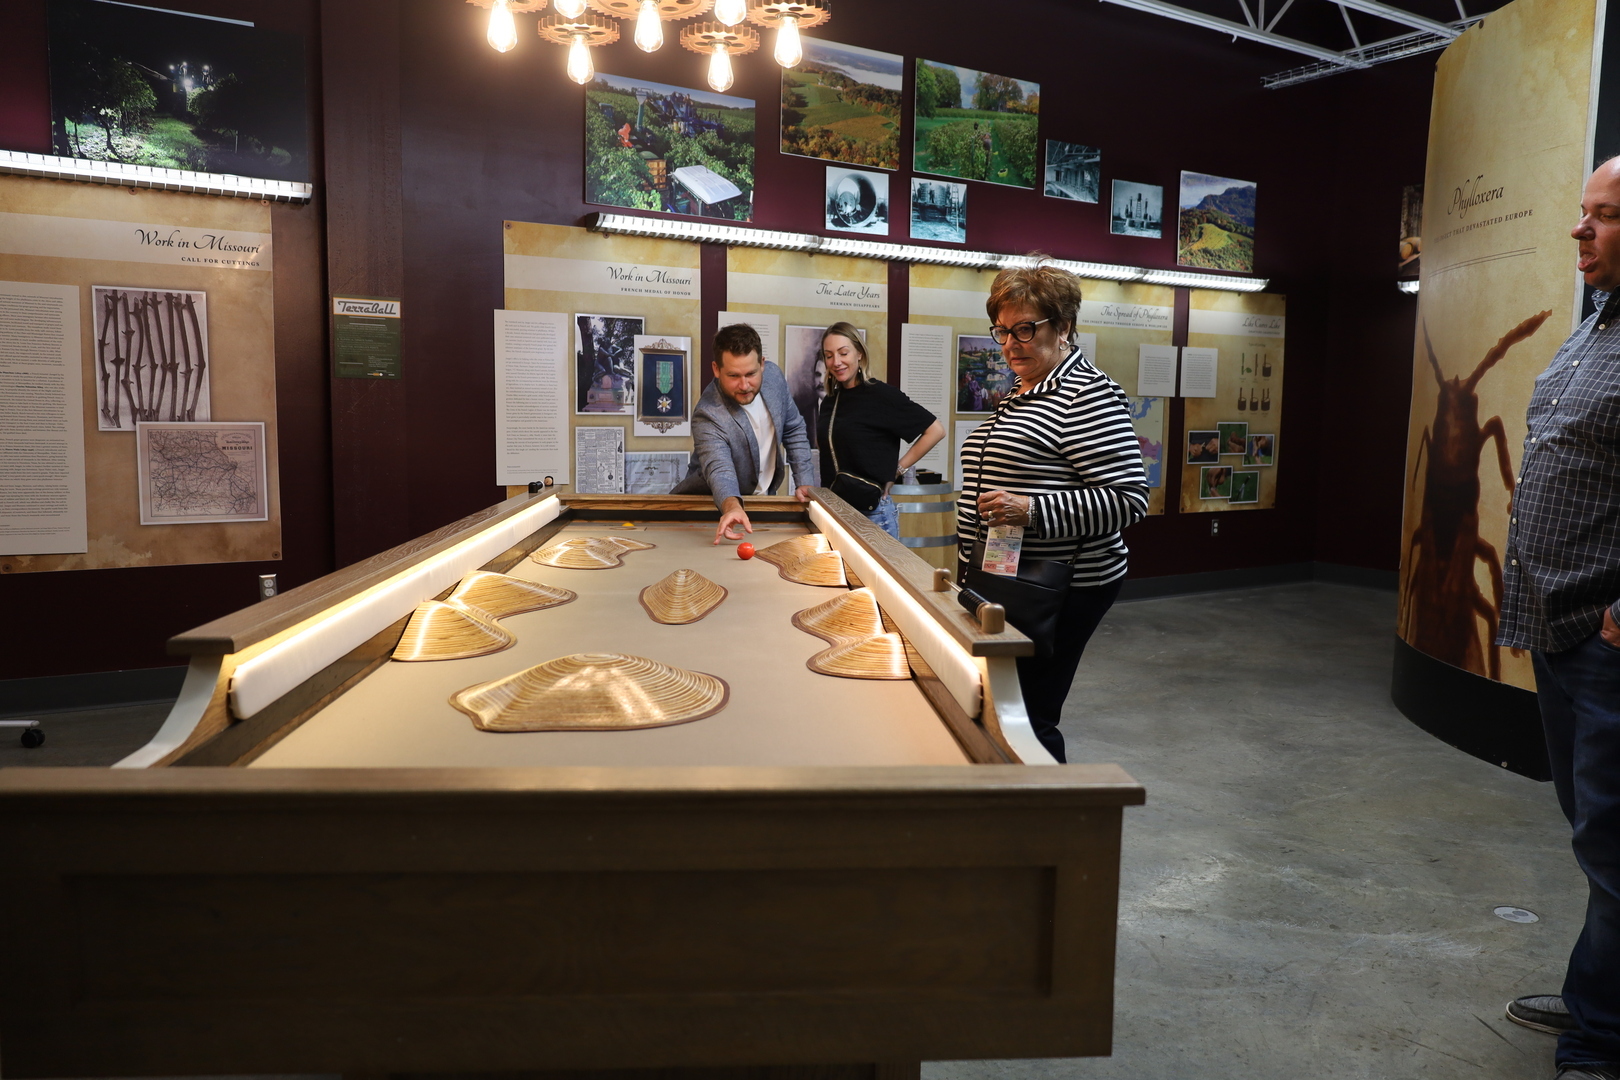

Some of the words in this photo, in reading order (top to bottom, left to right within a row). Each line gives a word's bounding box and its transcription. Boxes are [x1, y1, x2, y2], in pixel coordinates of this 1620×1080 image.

[1447, 174, 1504, 220] Phylloxera
[1453, 226, 1465, 237] THAT
[1465, 216, 1503, 231] DEVASTATED
[1504, 209, 1534, 222] EUROPE
[134, 229, 181, 248] Work
[177, 238, 191, 248] in
[193, 234, 261, 254] Missouri
[221, 259, 260, 267] CUTTINGS
[606, 266, 638, 281] Work
[635, 273, 643, 282] in
[645, 270, 692, 285] Missouri
[815, 281, 832, 296] The
[833, 284, 856, 297] Later
[856, 286, 880, 300] Years
[337, 300, 396, 315] TerraBall
[1100, 304, 1113, 316] The
[1113, 306, 1136, 320] Spread
[1132, 306, 1142, 322] of
[1139, 307, 1168, 323] Phylloxera
